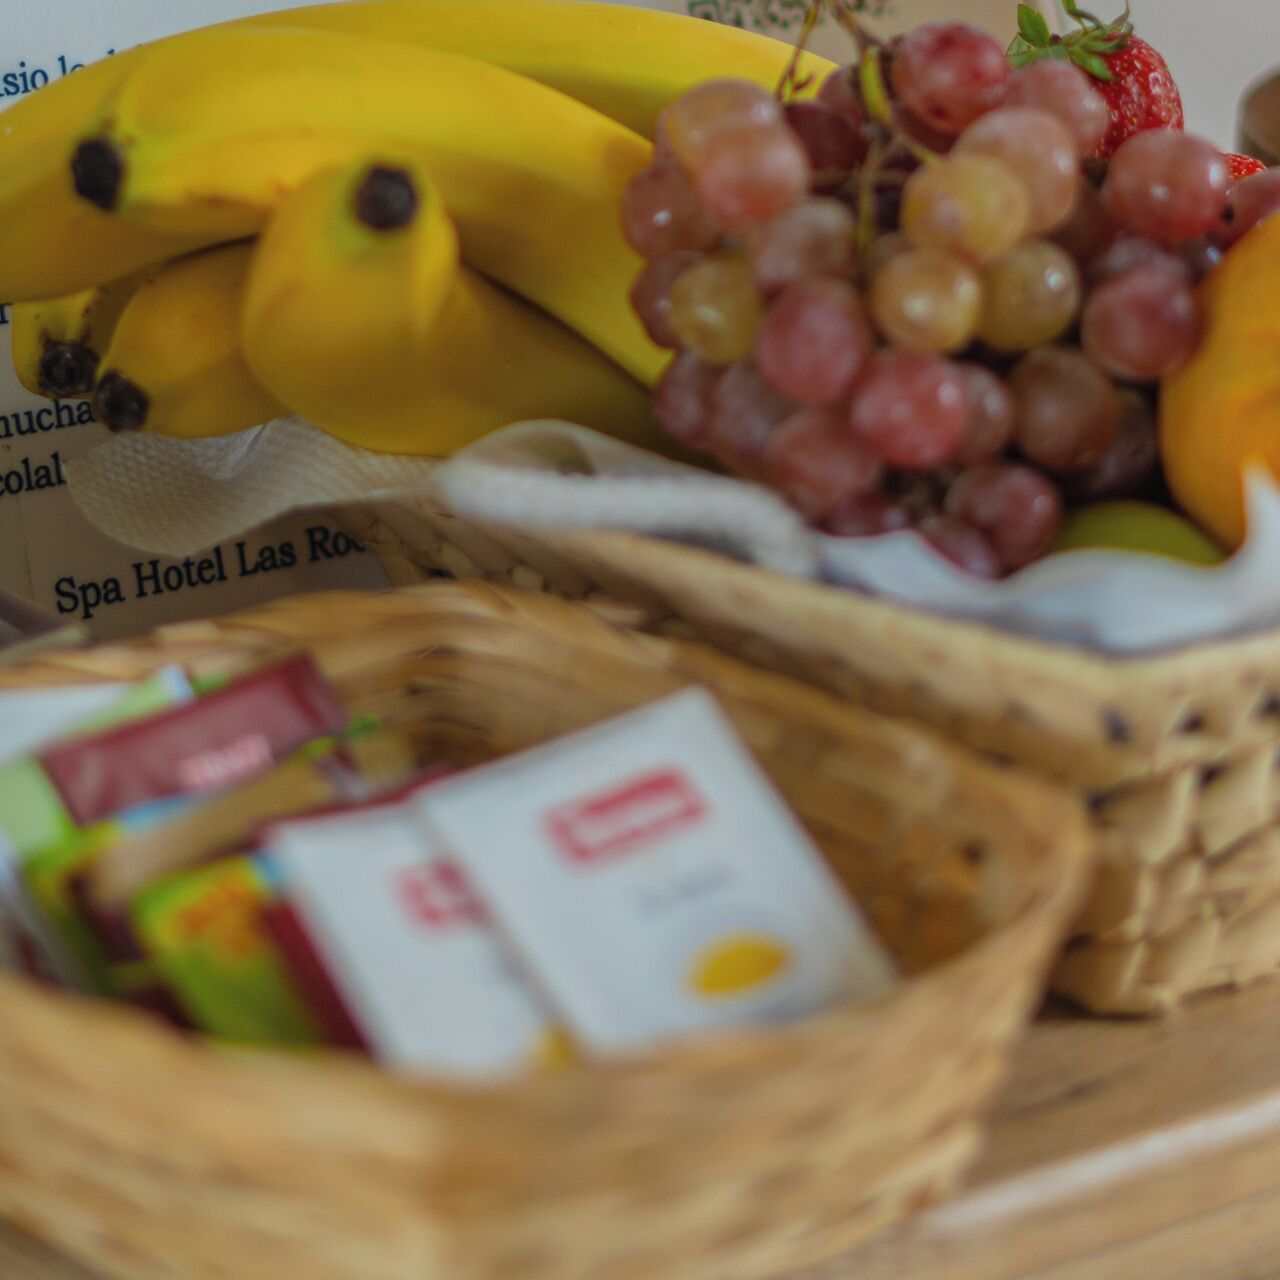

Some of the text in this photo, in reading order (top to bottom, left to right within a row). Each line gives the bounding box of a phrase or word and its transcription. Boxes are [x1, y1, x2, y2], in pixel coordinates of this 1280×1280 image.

[55, 577, 125, 619] Spa
[132, 546, 227, 598] Hotel
[235, 542, 296, 577] Las
